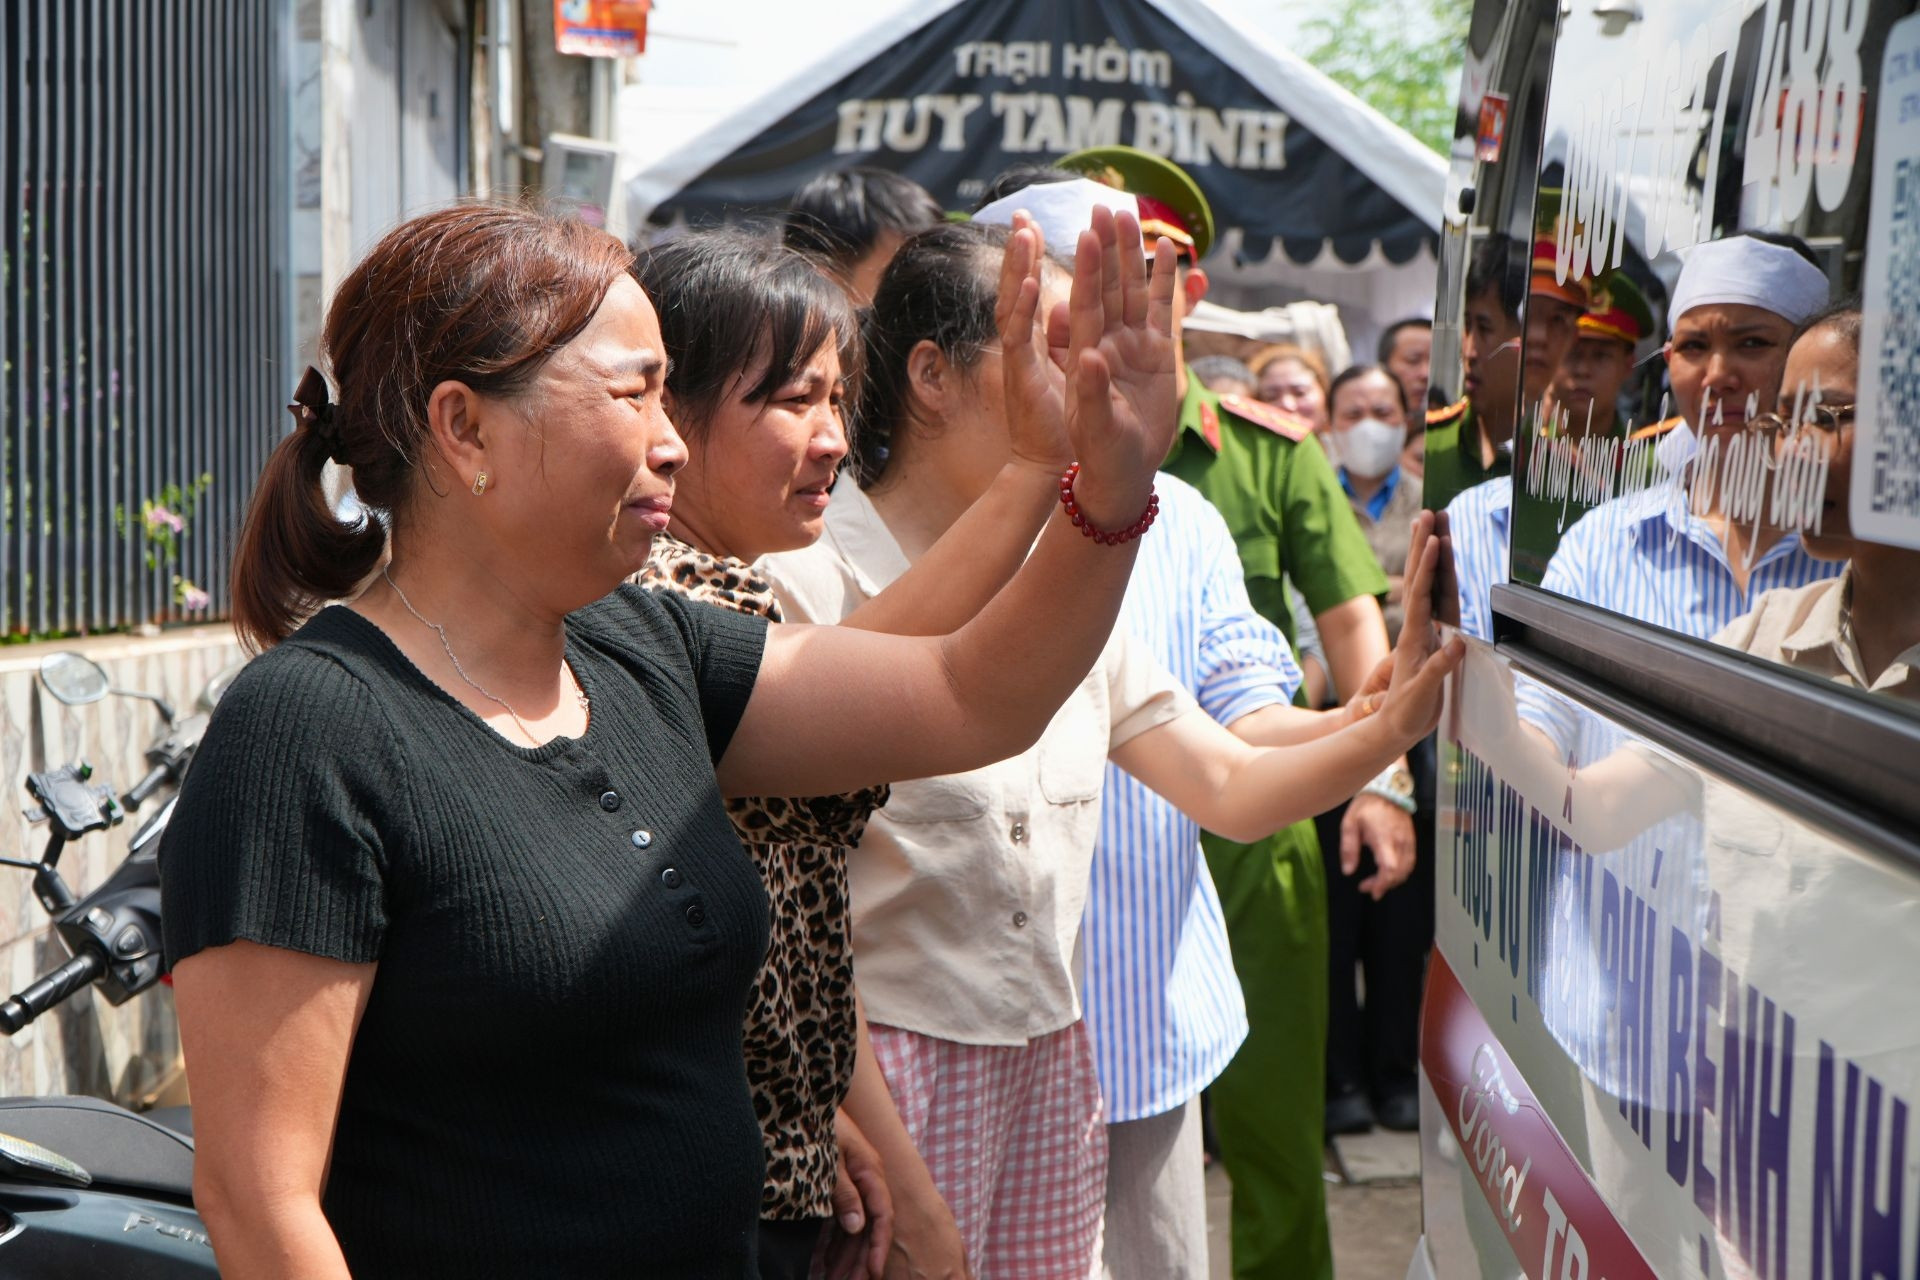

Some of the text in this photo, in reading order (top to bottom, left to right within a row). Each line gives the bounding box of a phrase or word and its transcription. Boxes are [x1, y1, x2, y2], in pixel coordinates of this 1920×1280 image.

[954, 41, 1052, 85] TRẠI
[834, 94, 983, 154] HUY
[1453, 738, 1920, 1280] PHỤC VỤ MIỄN PHÍ BỆNH NH
